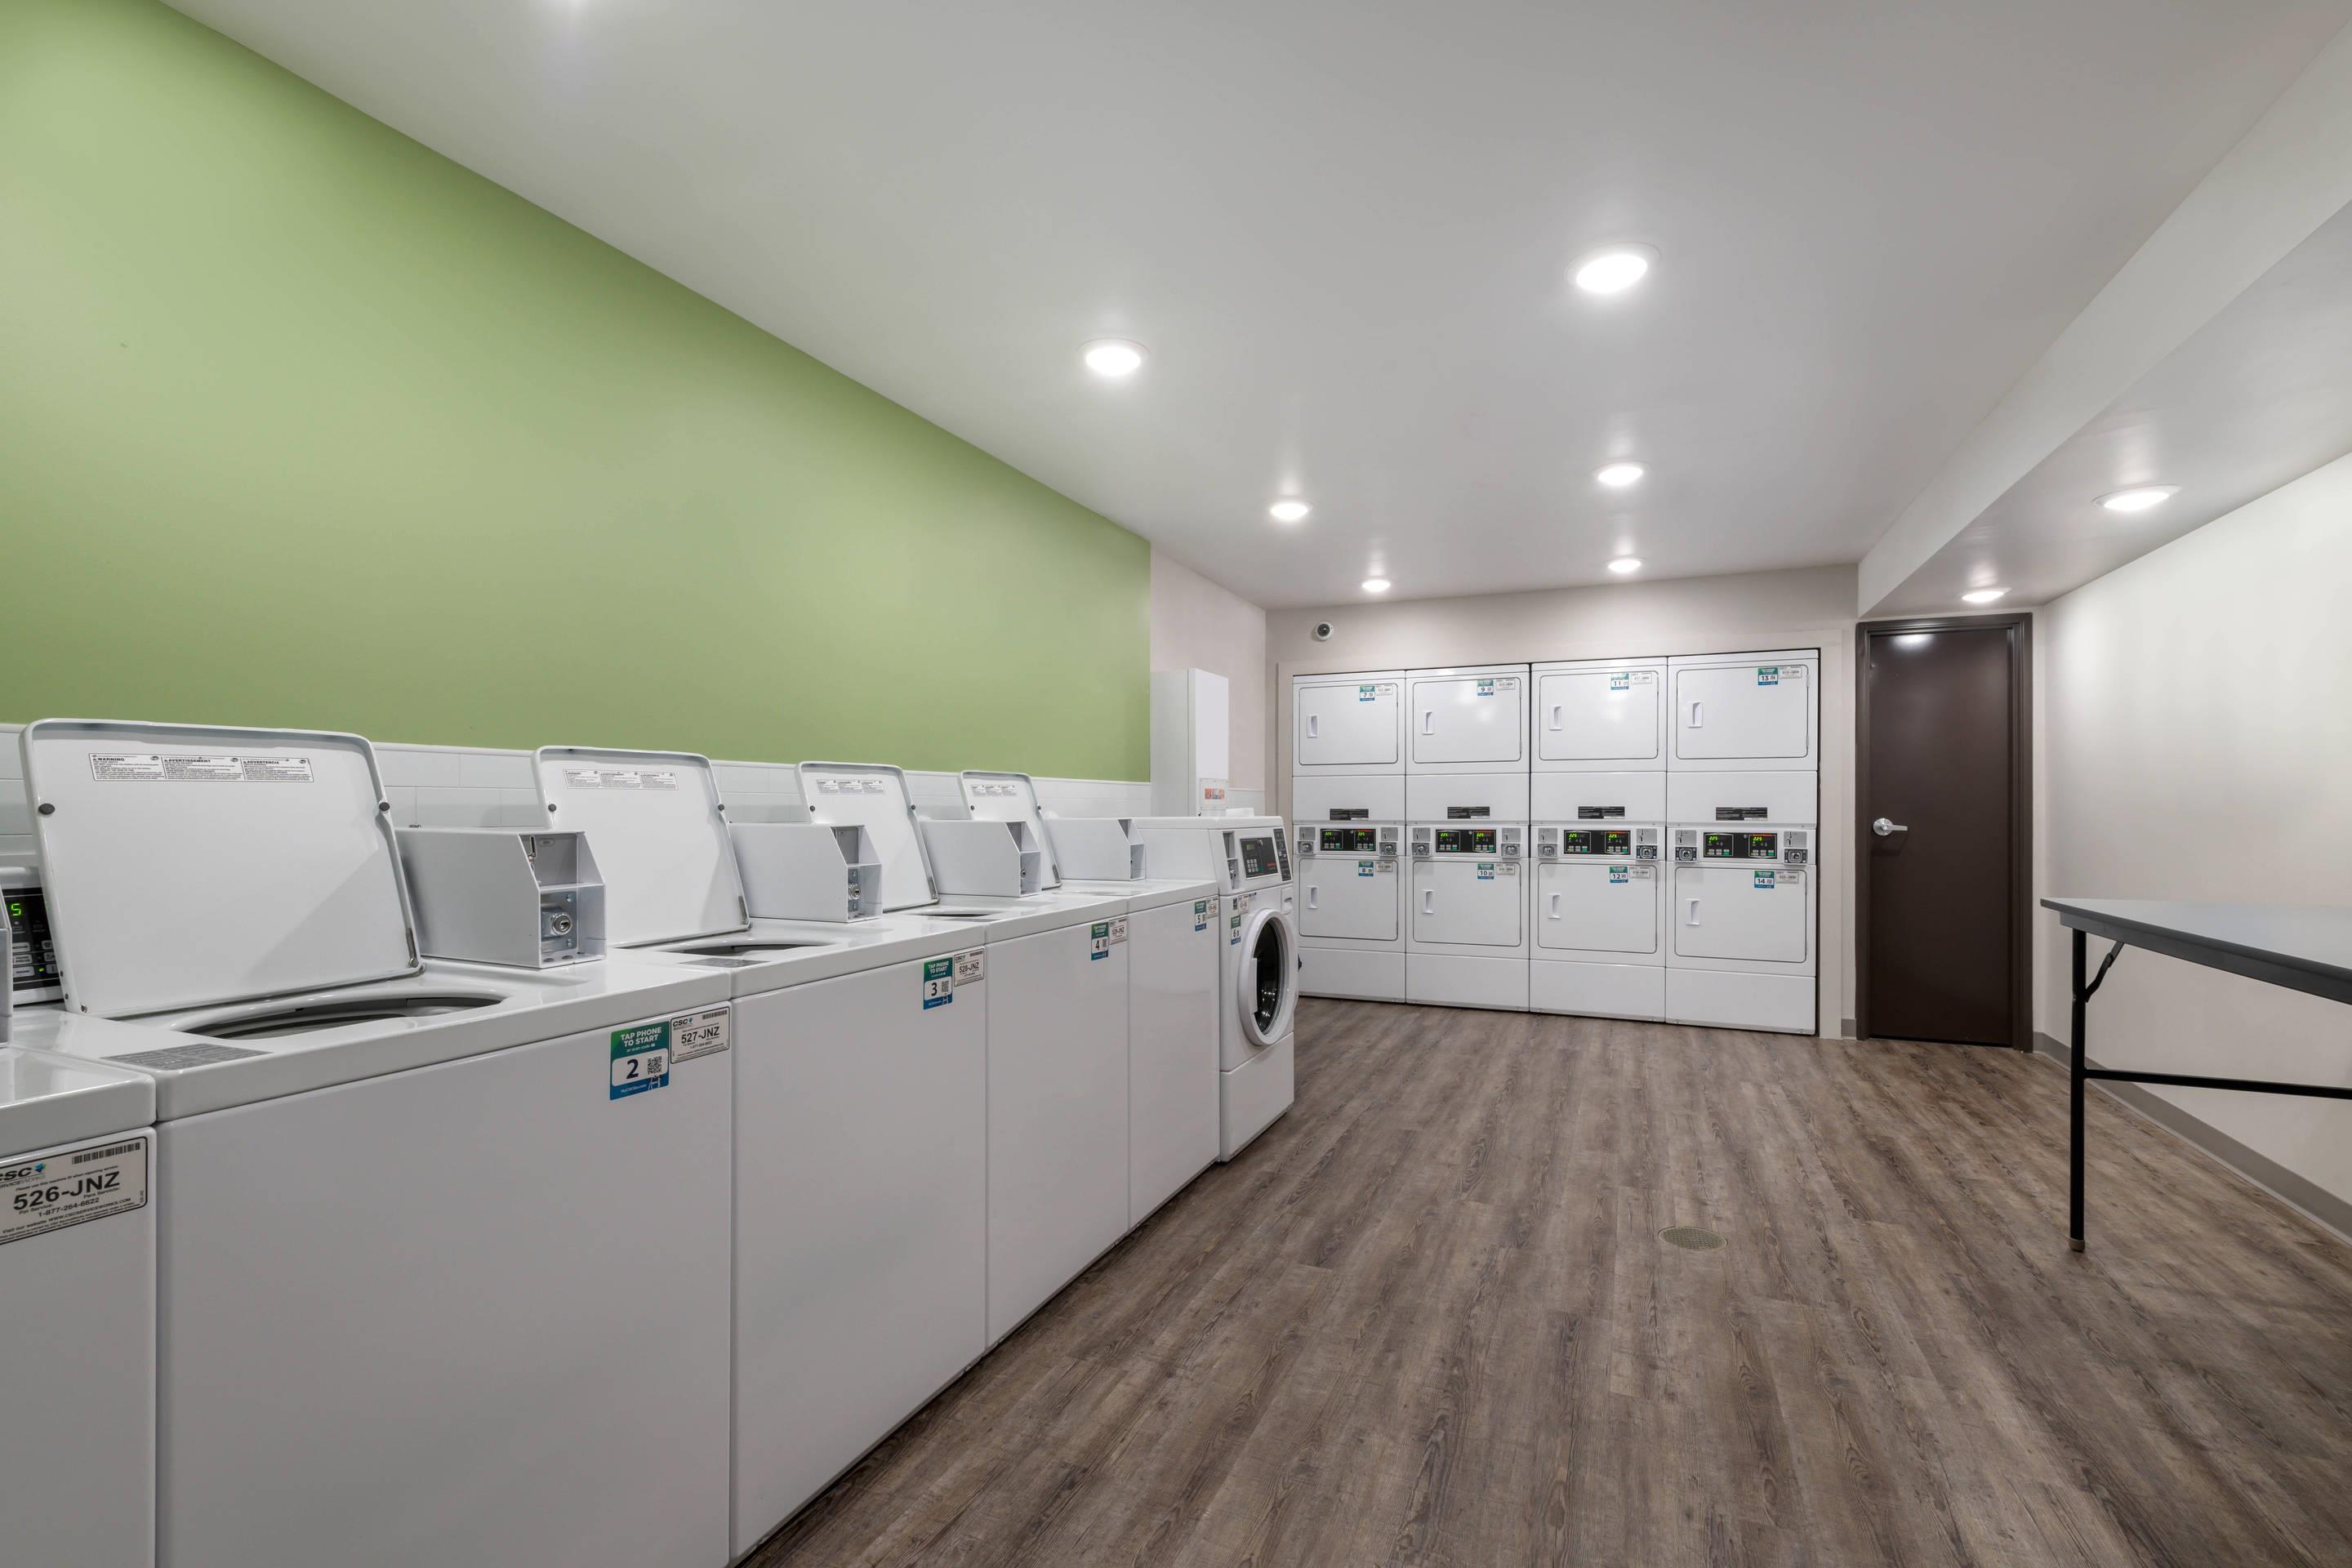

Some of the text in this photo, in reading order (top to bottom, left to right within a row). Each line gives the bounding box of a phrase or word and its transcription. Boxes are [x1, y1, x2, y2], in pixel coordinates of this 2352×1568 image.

[1197, 915, 1201, 924] 5
[1095, 939, 1100, 951] 4
[959, 962, 979, 973] 528-JNZ
[931, 982, 938, 996] 3
[672, 1018, 688, 1027] CSC
[621, 1027, 662, 1042] TAP PHONE
[623, 1034, 659, 1048] TO START
[681, 1027, 720, 1045] 527-JNZ
[626, 1058, 639, 1080] 2
[13, 1171, 120, 1210] 526-JNZ
[38, 1197, 100, 1218] 1-877-264-6622
